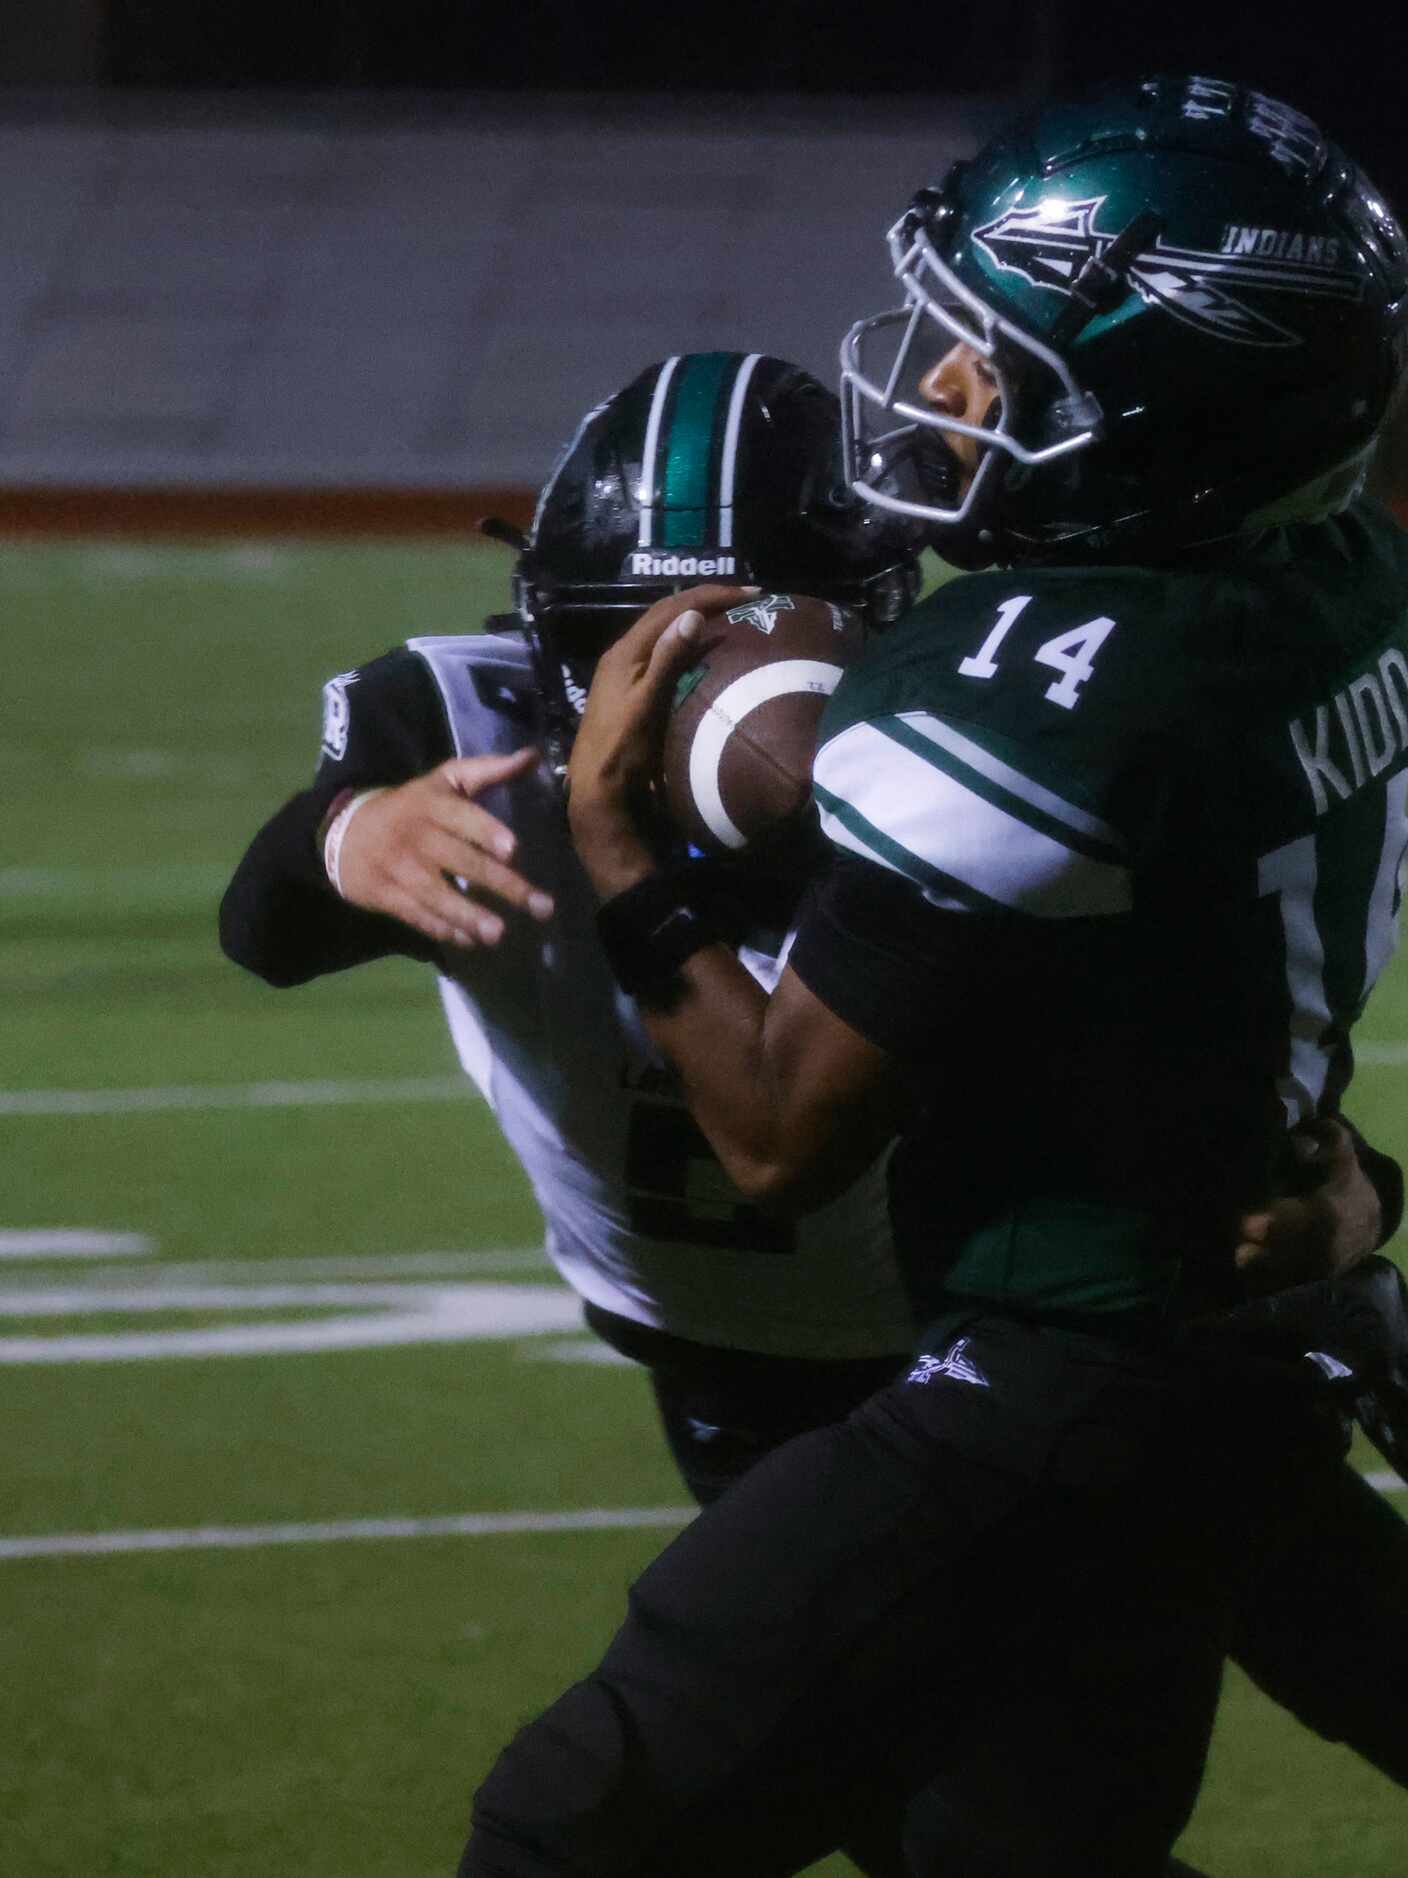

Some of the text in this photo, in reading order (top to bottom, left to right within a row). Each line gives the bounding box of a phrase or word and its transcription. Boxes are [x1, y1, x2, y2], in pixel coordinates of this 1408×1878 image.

[1221, 224, 1343, 263] INDIANS
[631, 552, 737, 576] Riddell
[957, 595, 1118, 711] 14
